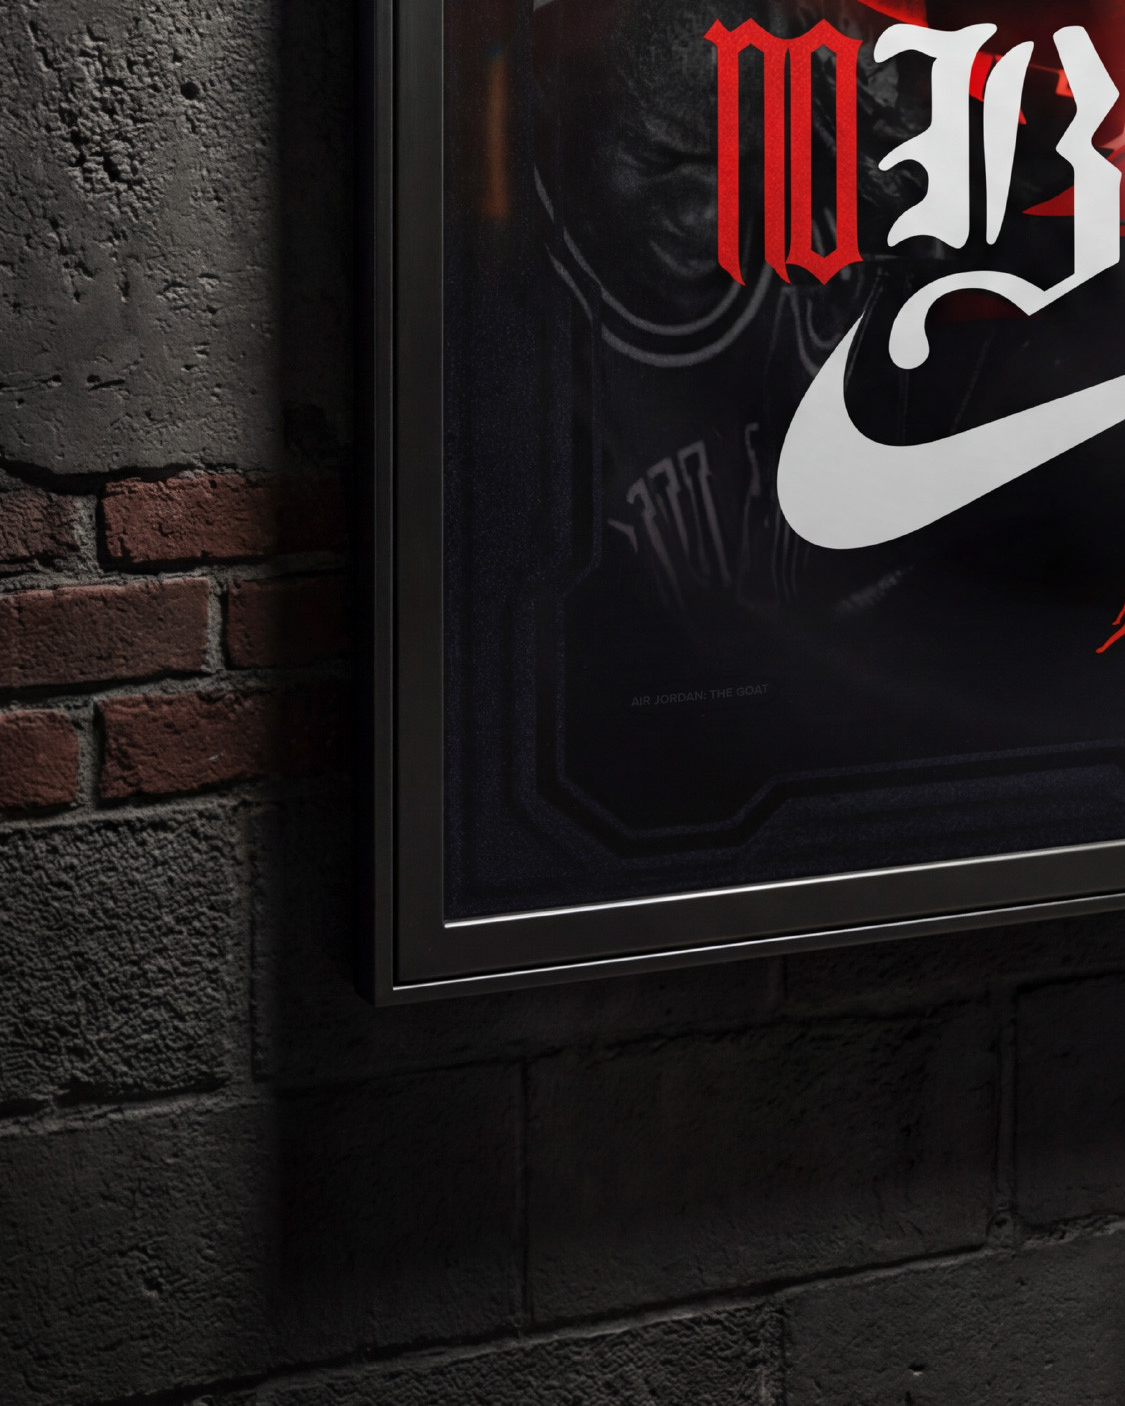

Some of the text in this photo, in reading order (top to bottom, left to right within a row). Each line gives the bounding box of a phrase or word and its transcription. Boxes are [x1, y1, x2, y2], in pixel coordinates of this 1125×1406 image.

[631, 683, 769, 707] AIR JORDAN: THE GOAT
